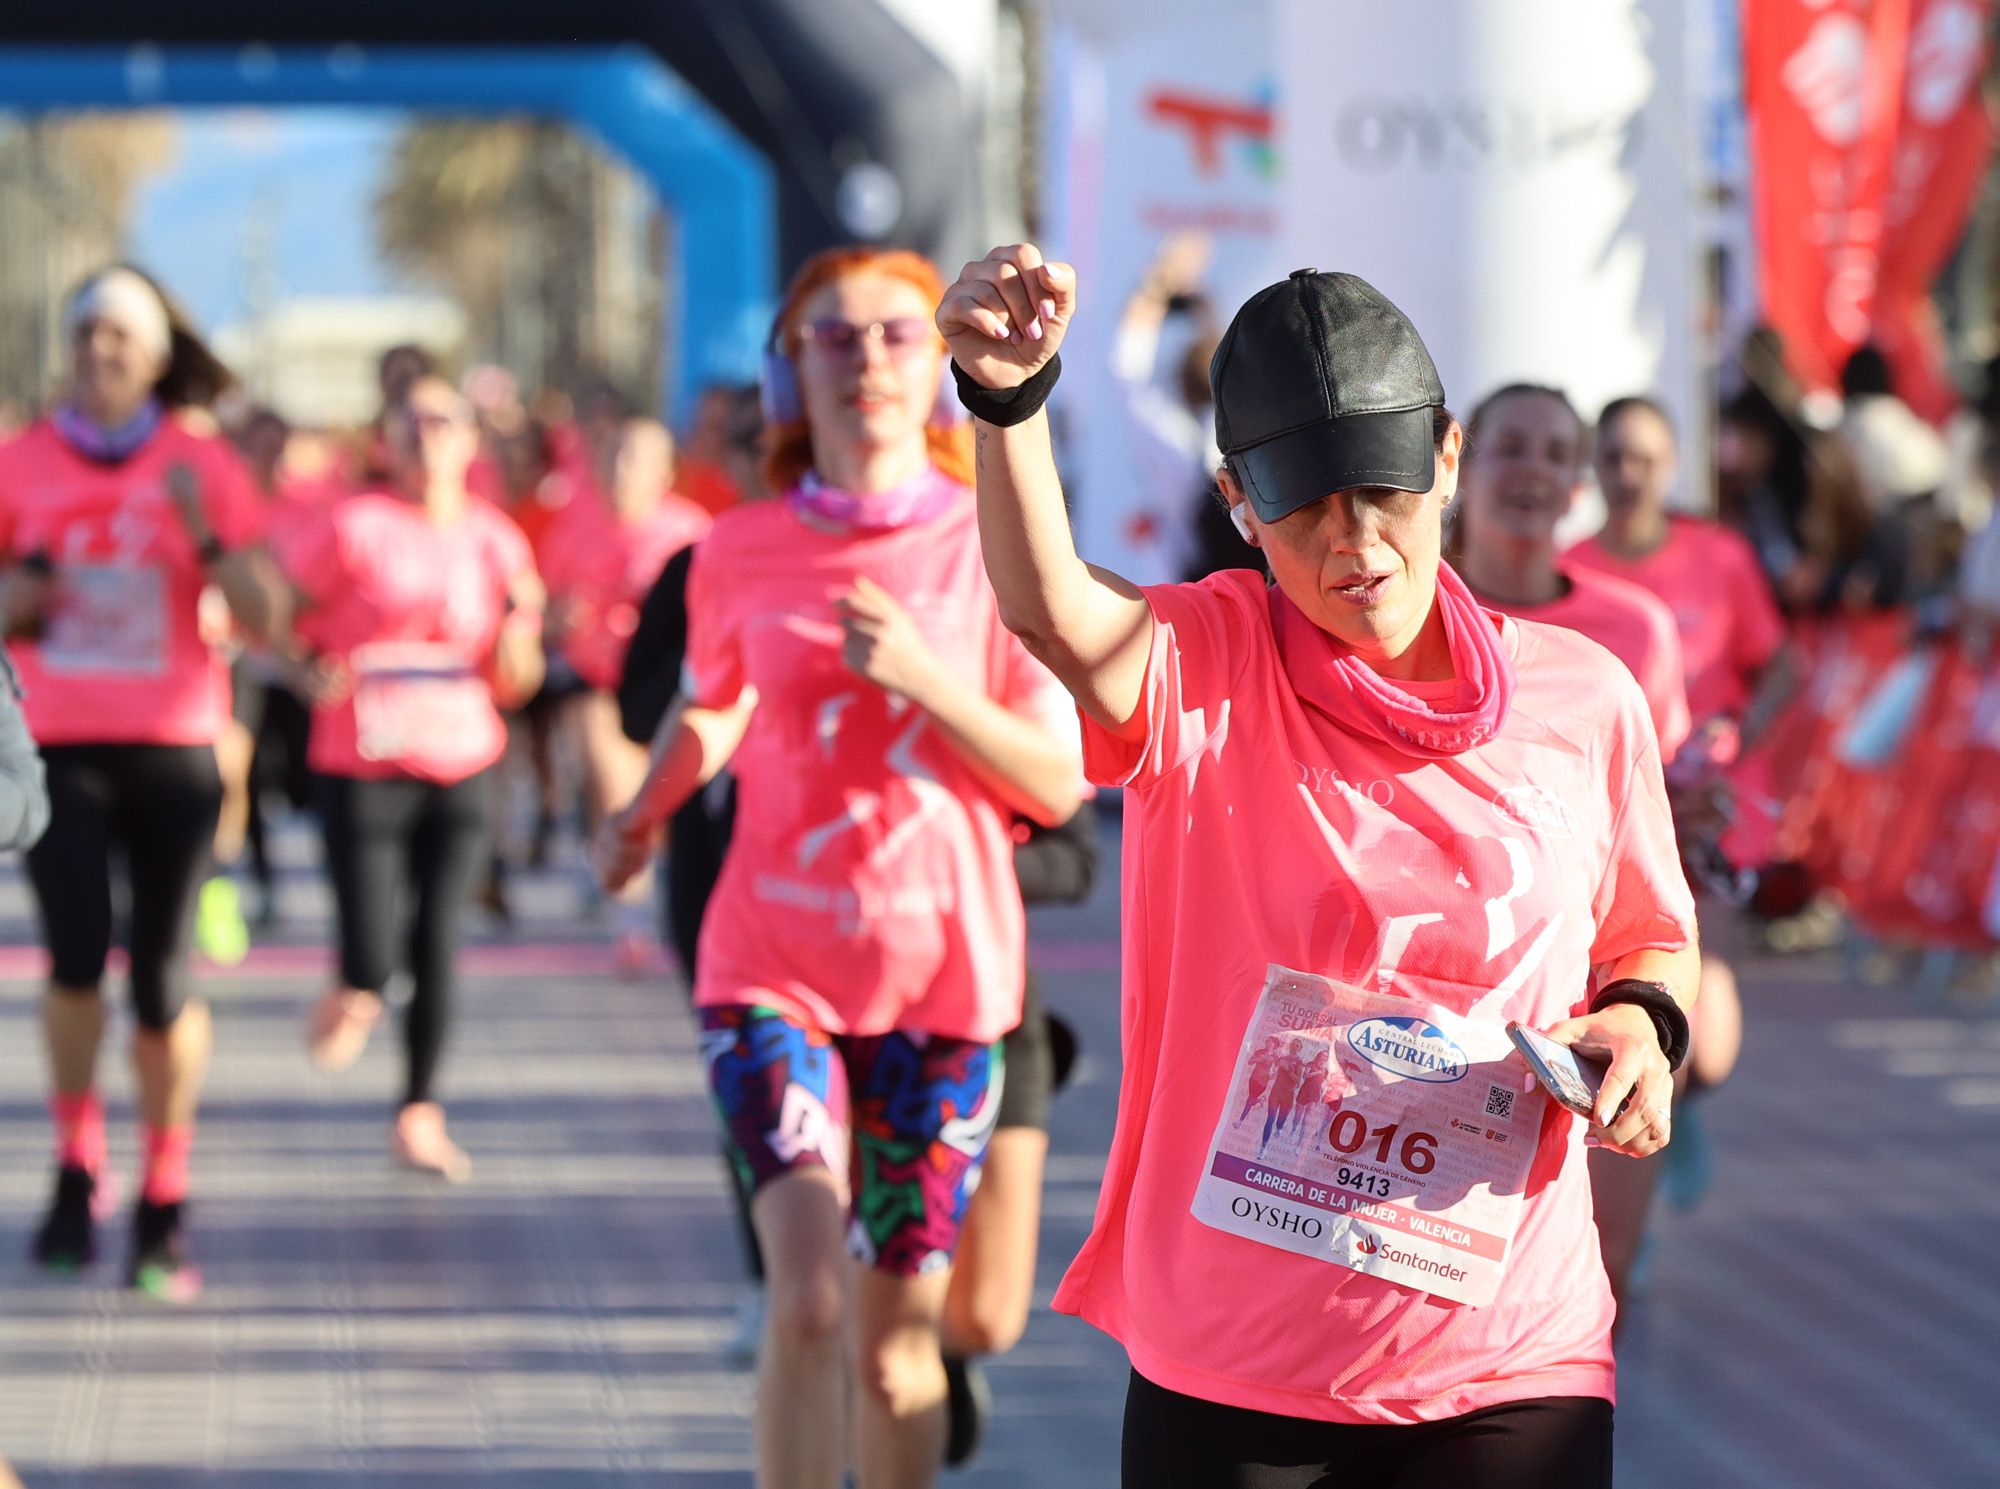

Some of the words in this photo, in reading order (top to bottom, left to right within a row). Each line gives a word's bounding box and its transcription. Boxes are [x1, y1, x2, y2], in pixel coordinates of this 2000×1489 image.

[1282, 1002, 1296, 1014] TU
[1298, 1008, 1338, 1026] DORSAL
[1354, 1026, 1458, 1077] ASTURIANA
[1378, 1028, 1417, 1045] CENTRAL
[1329, 1110, 1439, 1175] 016
[1336, 1167, 1391, 1197] 9413
[1355, 1160, 1389, 1176] VIOLENCIA
[1390, 1171, 1399, 1179] DE
[1231, 1196, 1322, 1239] OYSHO
[1245, 1168, 1304, 1198] CARRERA
[1308, 1188, 1328, 1204] DE
[1330, 1193, 1347, 1210] LA
[1351, 1199, 1398, 1224] MUJER
[1410, 1216, 1472, 1247] VALENCIA
[1379, 1243, 1468, 1283] Santander
